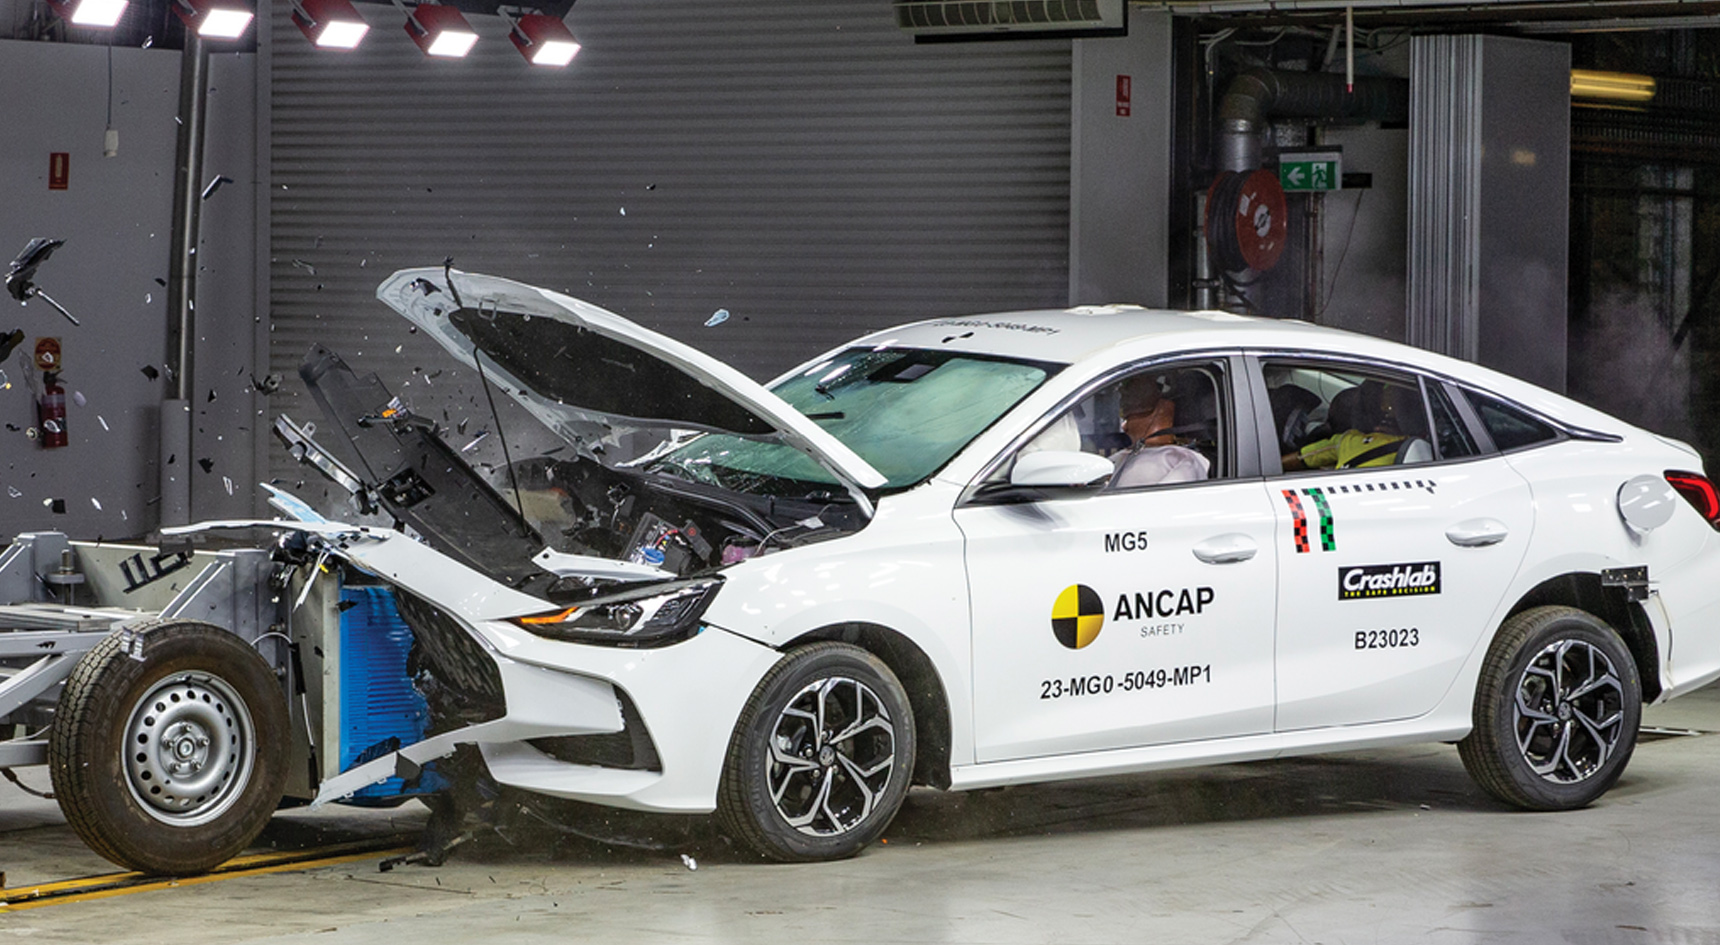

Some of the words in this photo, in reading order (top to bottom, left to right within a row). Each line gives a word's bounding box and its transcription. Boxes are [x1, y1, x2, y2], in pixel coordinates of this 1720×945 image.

[1104, 531, 1148, 552] MG5
[1343, 565, 1436, 591] Crashlab
[1113, 587, 1215, 621] ANCAP
[1140, 624, 1185, 638] SAFETY
[1355, 628, 1420, 650] B23023
